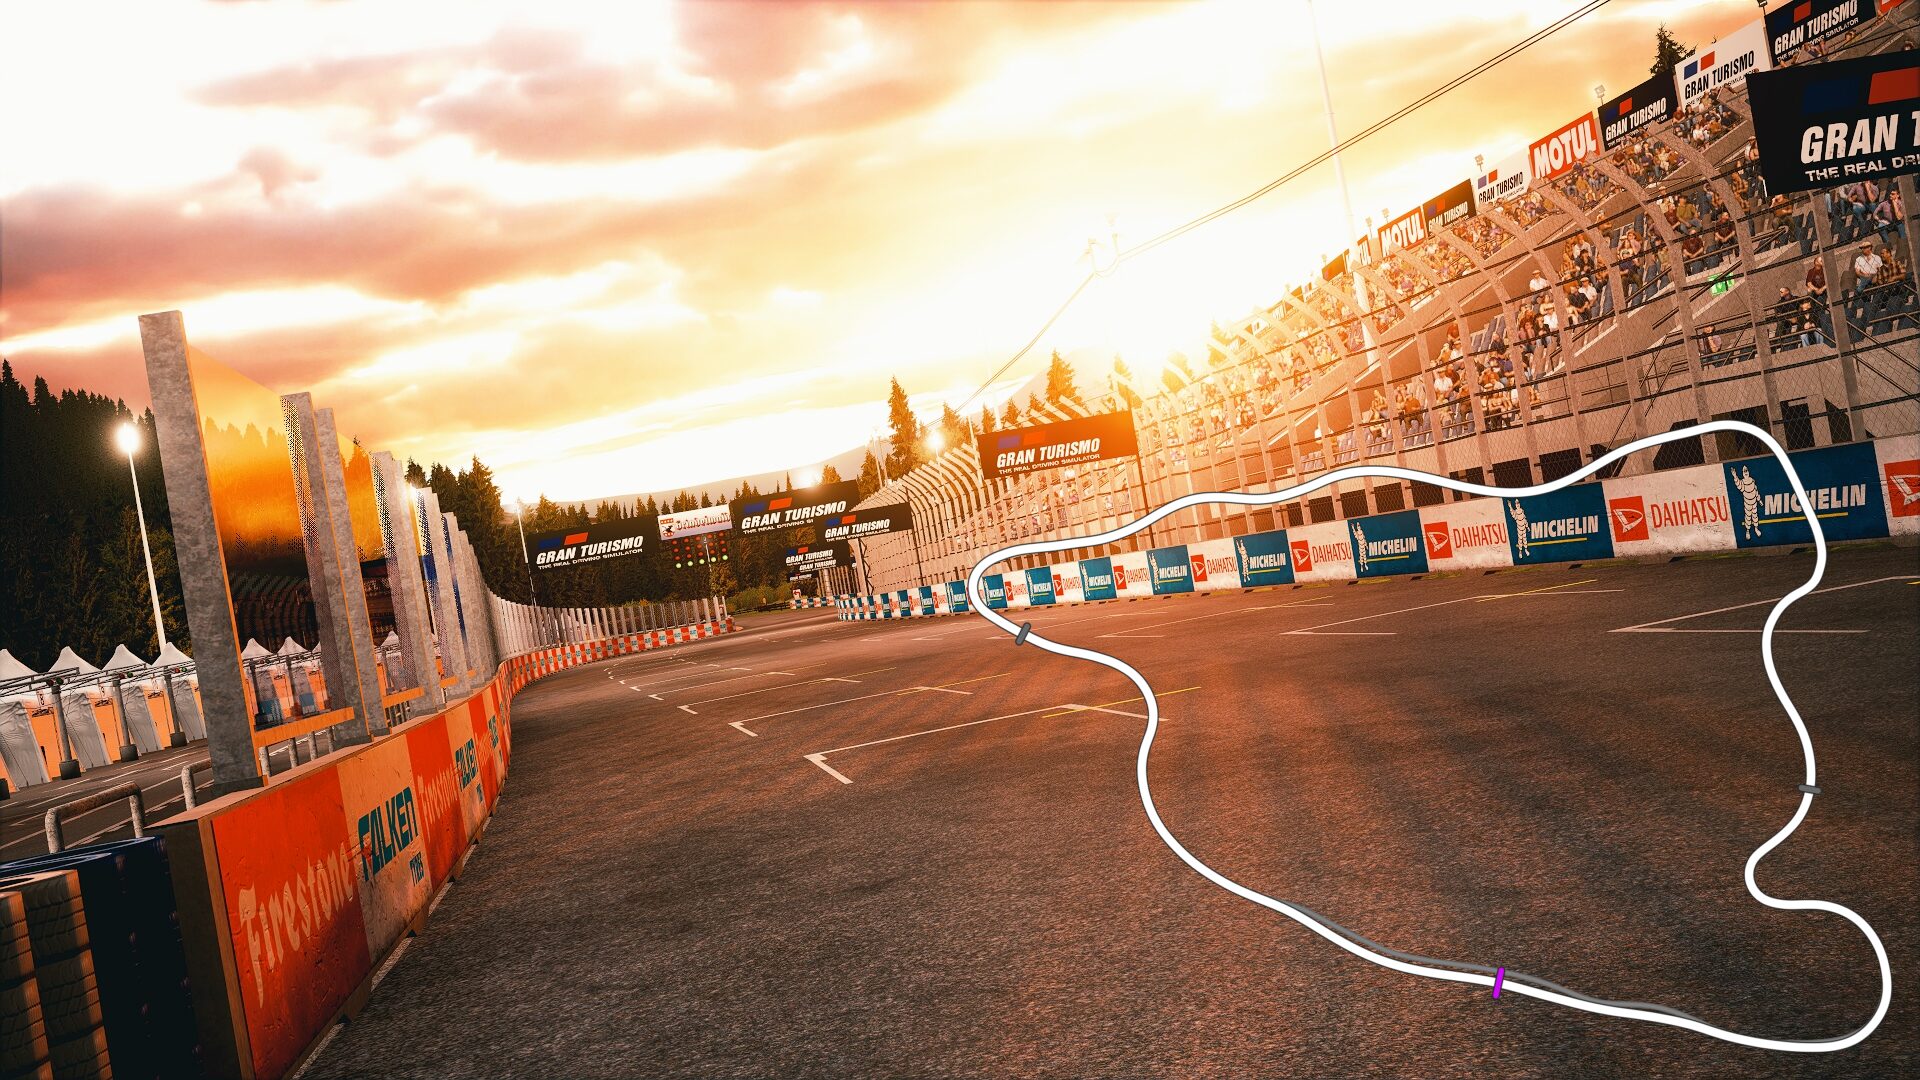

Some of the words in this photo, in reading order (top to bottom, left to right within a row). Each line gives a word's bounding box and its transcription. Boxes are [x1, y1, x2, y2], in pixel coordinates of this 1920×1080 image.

[1774, 25, 1804, 55] GRAN
[1807, 0, 1858, 39] TURISMO
[1685, 74, 1709, 100] GRAN
[1712, 50, 1755, 86] TURISMO
[1606, 117, 1628, 142] GRAN
[1629, 97, 1667, 129] TURISMO
[1534, 120, 1597, 180] MOTUL
[1801, 113, 1899, 164] GRAN
[1805, 166, 1840, 182] THE
[1844, 160, 1887, 177] REAL
[1478, 186, 1495, 203] GRAN
[1496, 172, 1524, 196] TURISMO
[1380, 212, 1424, 258] MOTUL
[997, 448, 1035, 468] GRAN
[1040, 438, 1101, 461] TURISMO
[1061, 453, 1100, 465] SIMULATOR
[741, 511, 781, 530] GRAN
[785, 500, 847, 522] TURISMO
[1650, 495, 1729, 529] DAIHATSU
[825, 525, 850, 538] GRAN
[851, 518, 890, 534] TURISMO
[1452, 522, 1507, 549] DAIHATSU
[1530, 515, 1599, 540] MICHELIN
[536, 546, 576, 565] GRAN
[581, 535, 644, 557] TURISMO
[602, 548, 643, 559] SIMULATOR
[785, 554, 804, 564] GRAN
[805, 549, 834, 560] TURISMO
[1311, 542, 1352, 564] DAIHATSU
[1368, 536, 1417, 557] MICHELIN
[1159, 565, 1188, 579] MICHELIN
[1206, 556, 1238, 575] DAIHATSU
[1249, 553, 1286, 569] MICHELIN
[1088, 574, 1111, 587] MICHELIN
[1125, 567, 1150, 583] DAIHATSU
[358, 786, 419, 882] FALKEN
[238, 841, 353, 1008] Firestone
